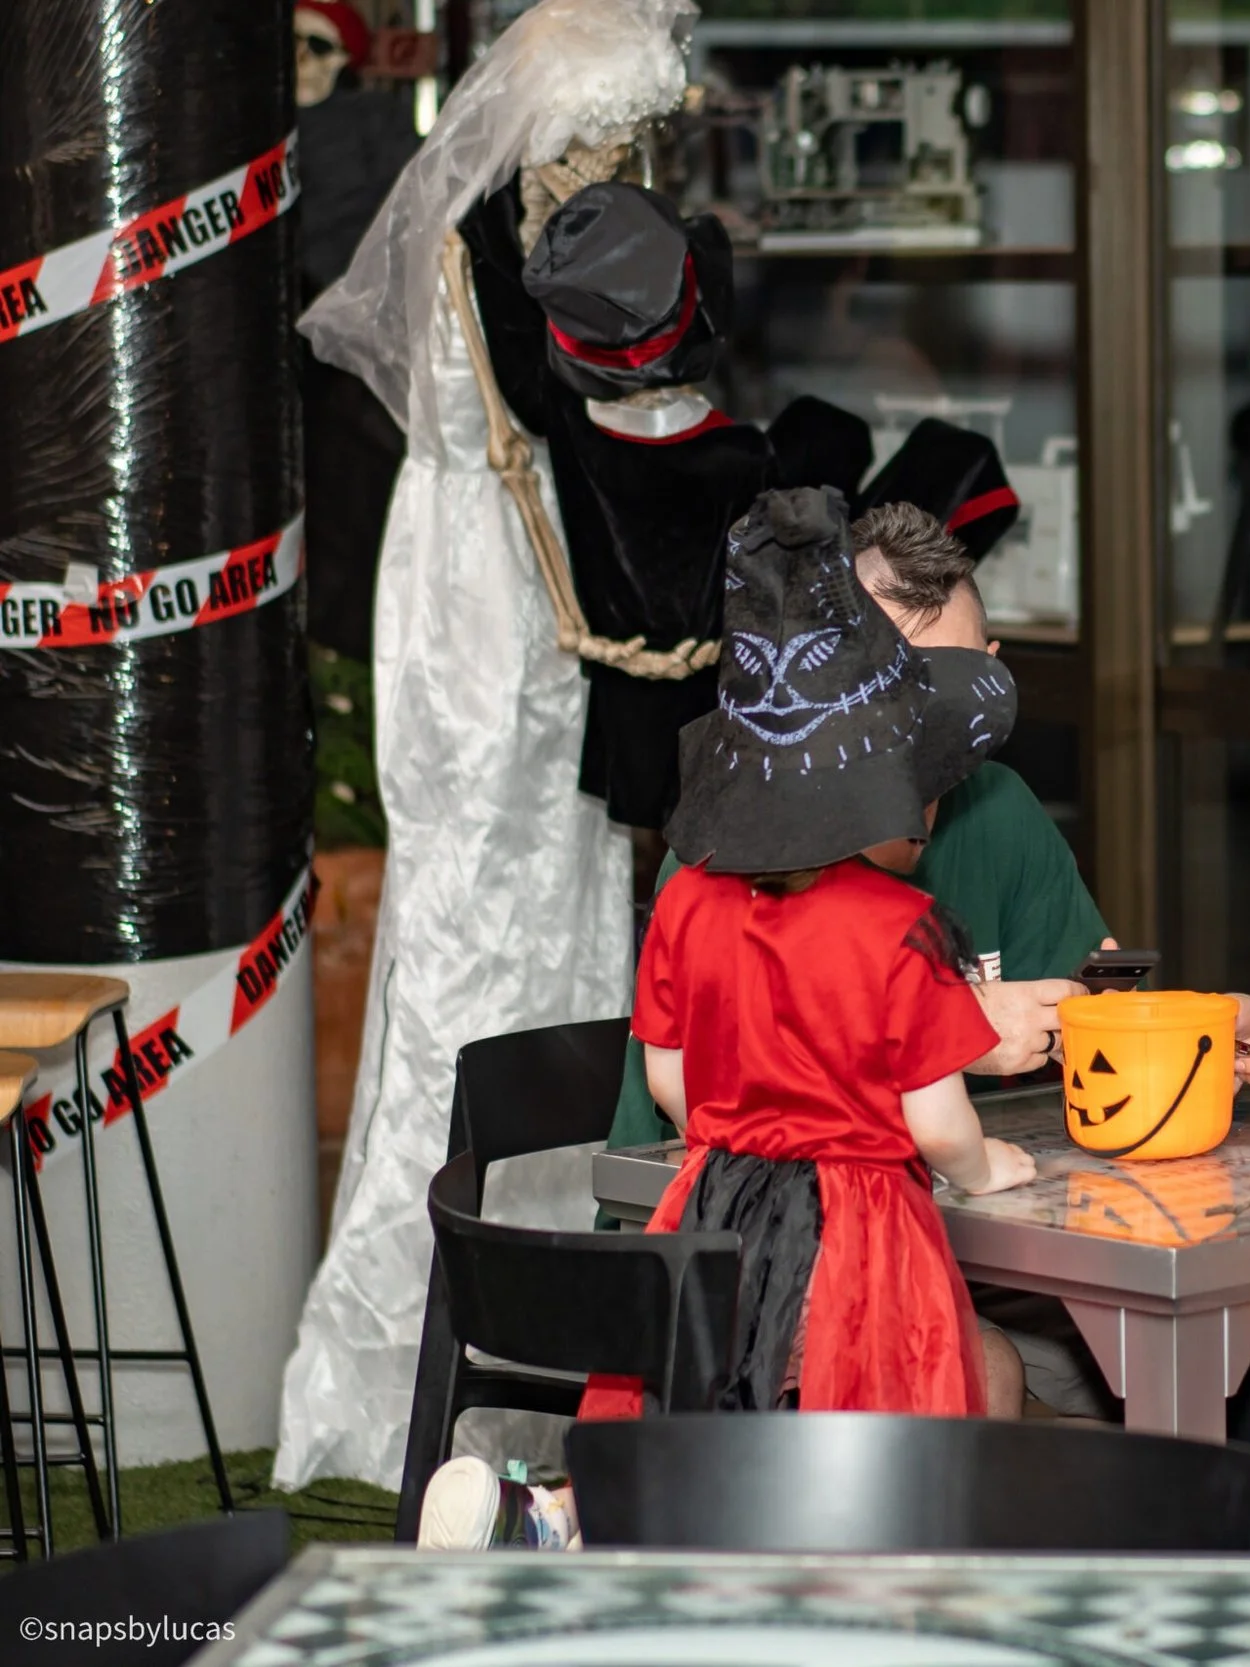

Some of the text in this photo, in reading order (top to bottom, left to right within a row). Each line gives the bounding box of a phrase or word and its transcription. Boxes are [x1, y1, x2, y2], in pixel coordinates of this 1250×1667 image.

[111, 190, 245, 278] DANGER
[254, 161, 286, 211] NO
[88, 589, 139, 633] NO
[149, 578, 200, 624] GO
[208, 552, 279, 611] AREA
[53, 1088, 105, 1136] GO
[101, 1028, 195, 1107] AREA
